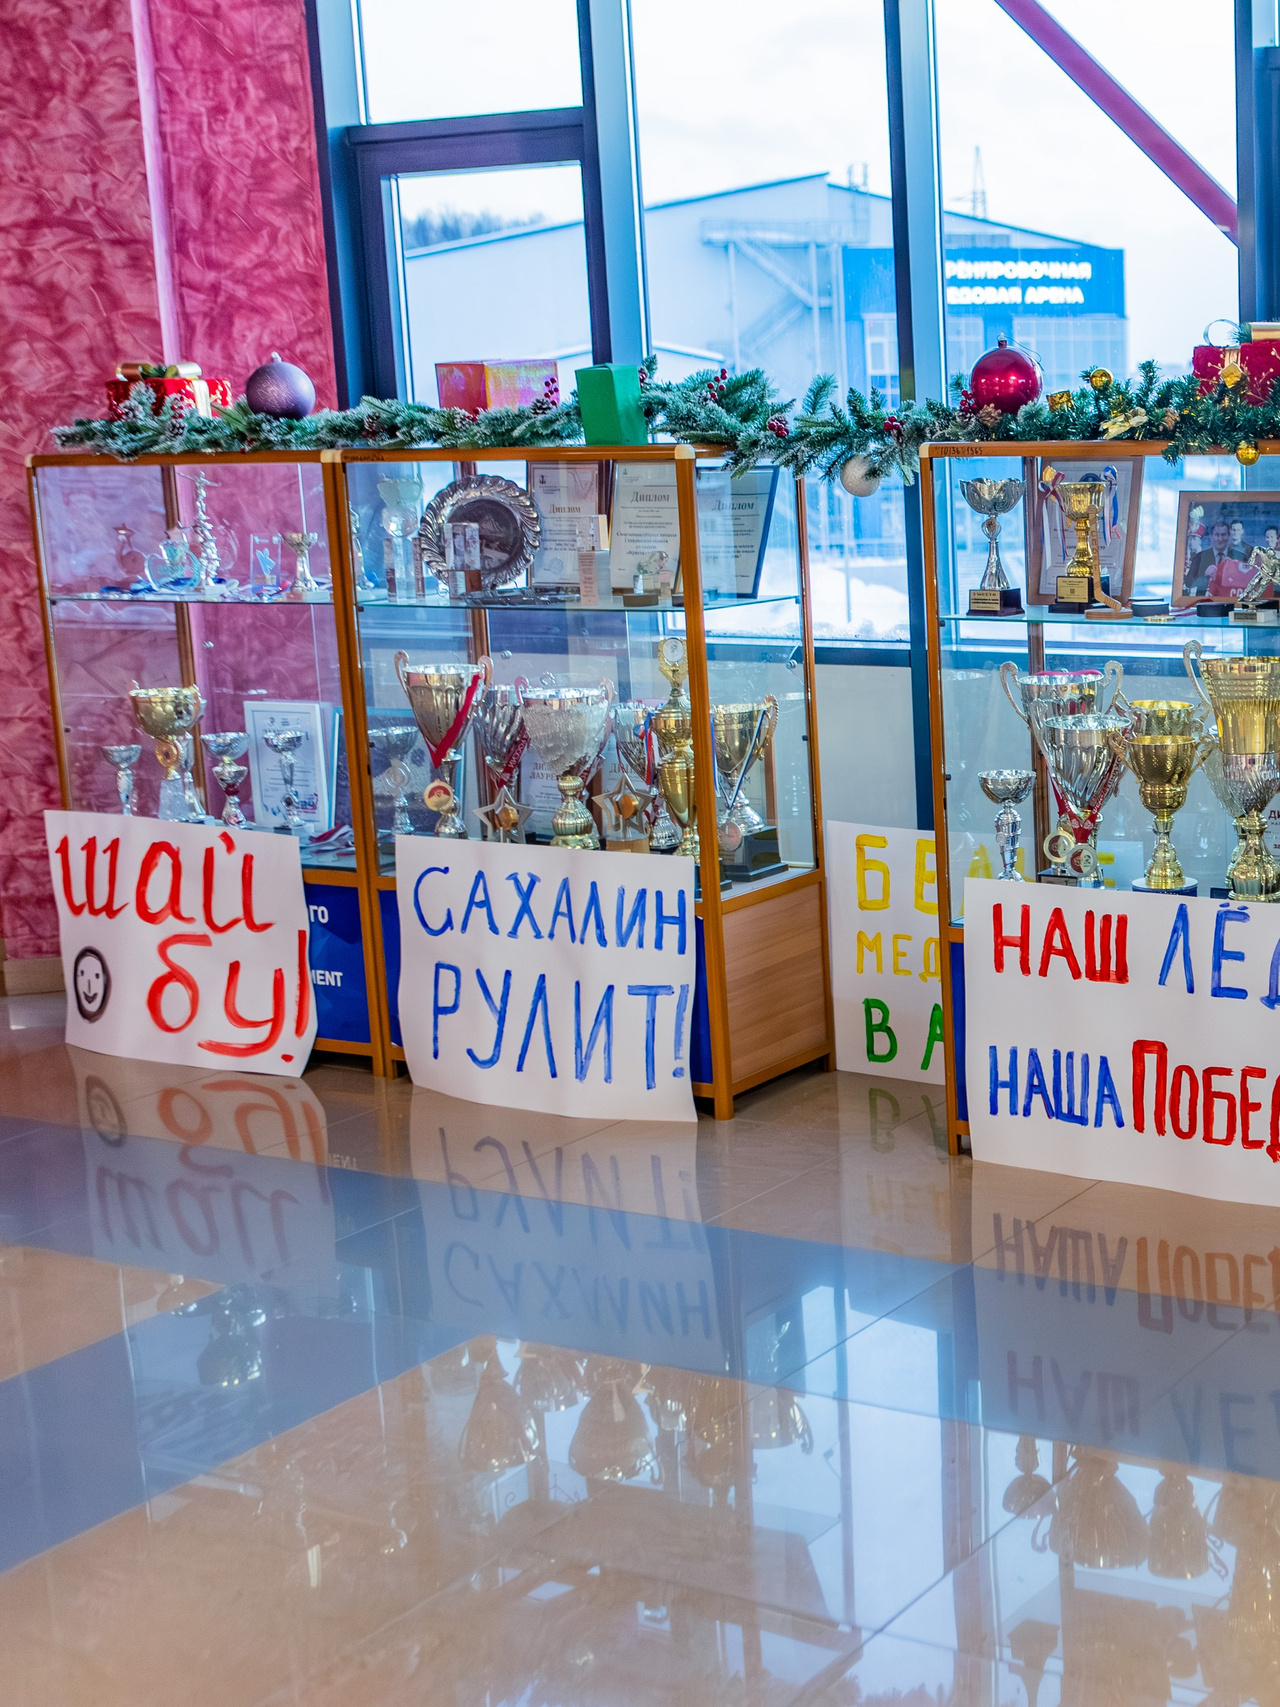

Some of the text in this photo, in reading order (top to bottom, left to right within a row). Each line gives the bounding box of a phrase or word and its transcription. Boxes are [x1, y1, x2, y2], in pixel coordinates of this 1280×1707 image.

[946, 260, 1091, 279] РЕНИРОВОЧНАЯ
[413, 866, 687, 955] САХАЛИН
[992, 903, 1130, 984] НАШ
[431, 961, 691, 1091] РУЛИТ!
[988, 1045, 1124, 1128] НАША
